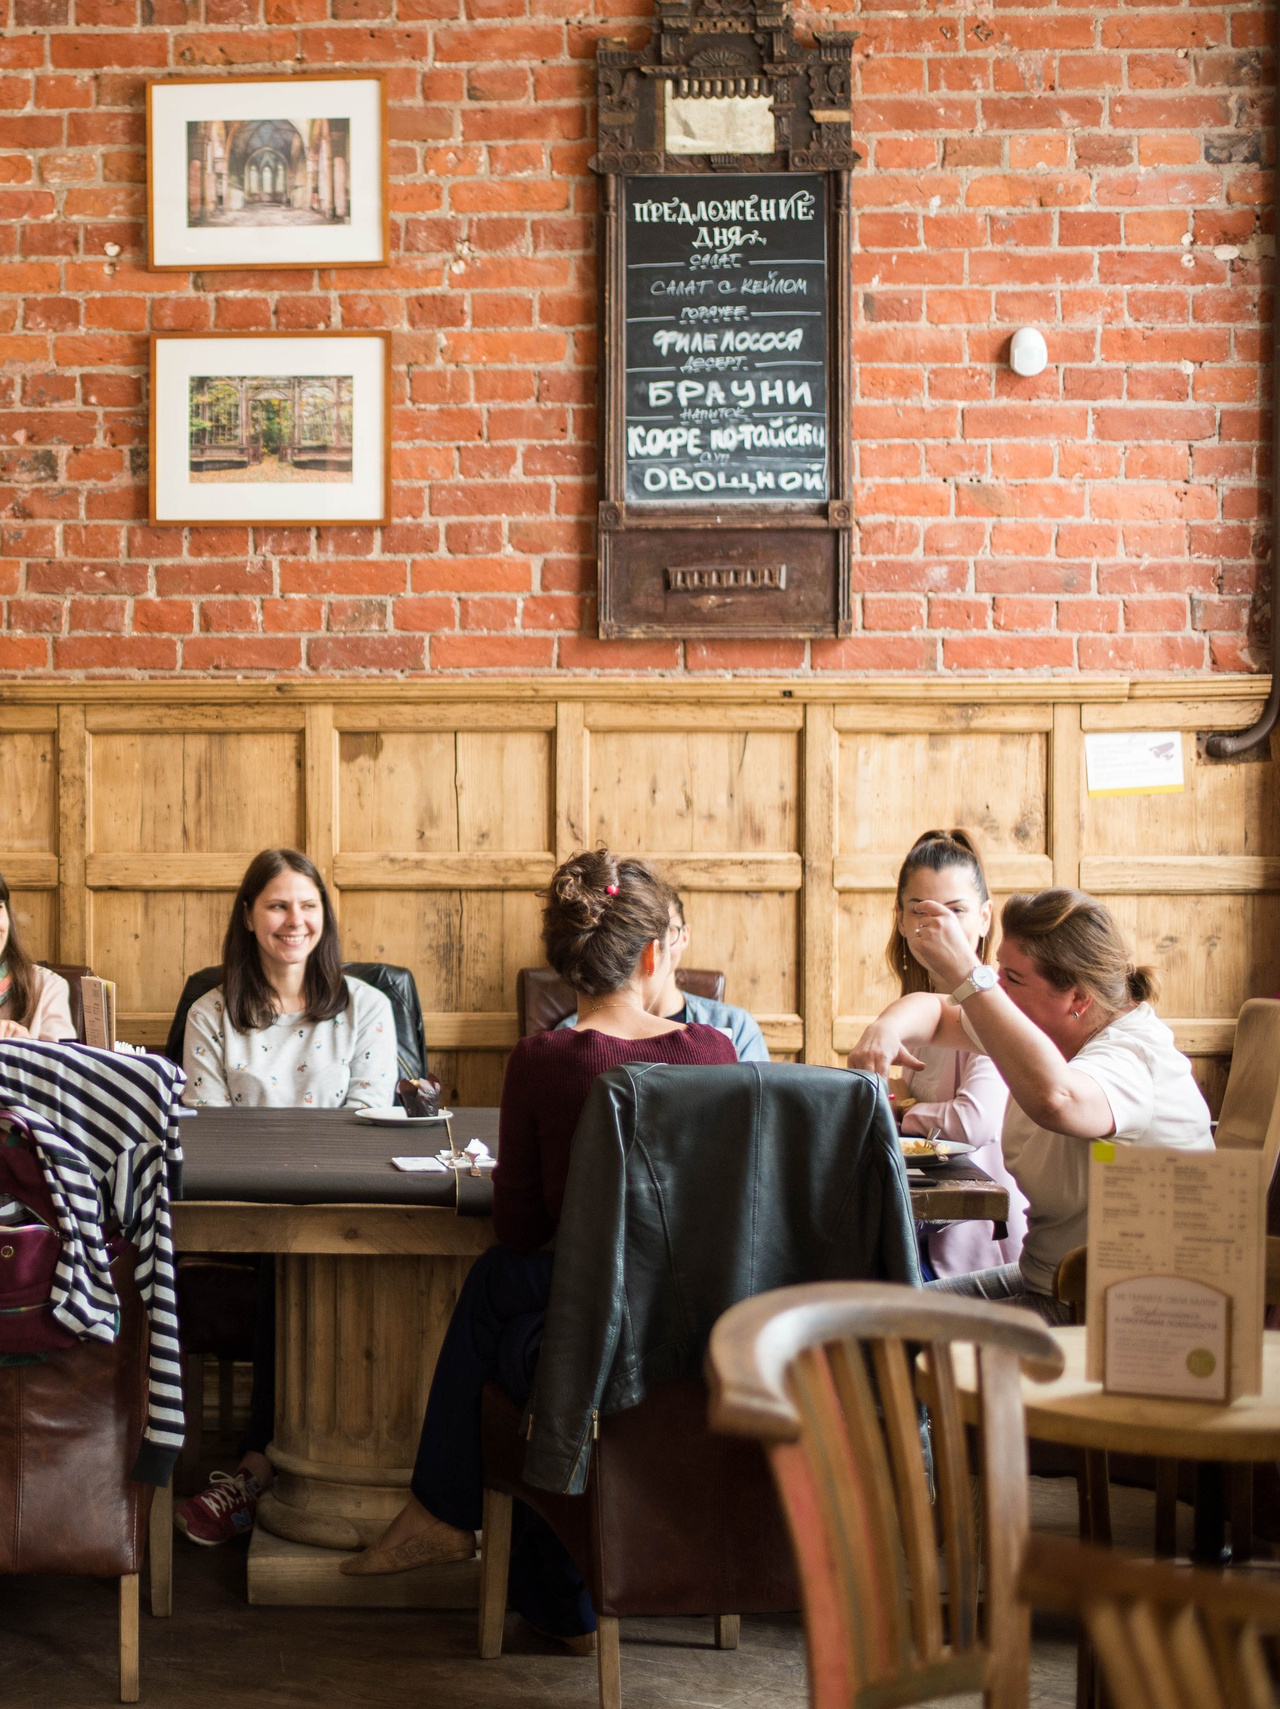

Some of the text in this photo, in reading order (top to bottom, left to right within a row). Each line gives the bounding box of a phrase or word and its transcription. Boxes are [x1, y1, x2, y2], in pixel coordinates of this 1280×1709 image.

[632, 190, 815, 226] ПРЕДЛОЖЕНИЕ
[691, 226, 766, 252] ДНЯ
[689, 253, 742, 266] САЛАТ
[650, 271, 807, 296] САЛАТ С КЕЙЛОМ
[680, 305, 748, 319] ГОРЯЧЕЕ
[652, 327, 804, 357] ФИЛЕ ЛОСОСЯ
[680, 355, 747, 373] ДЕСЕРТ
[648, 379, 813, 408] БРАУНИ
[680, 406, 748, 420] НАПИТОК
[627, 425, 702, 458] КОФЕ
[644, 463, 824, 495] ОВОЩНОЙ
